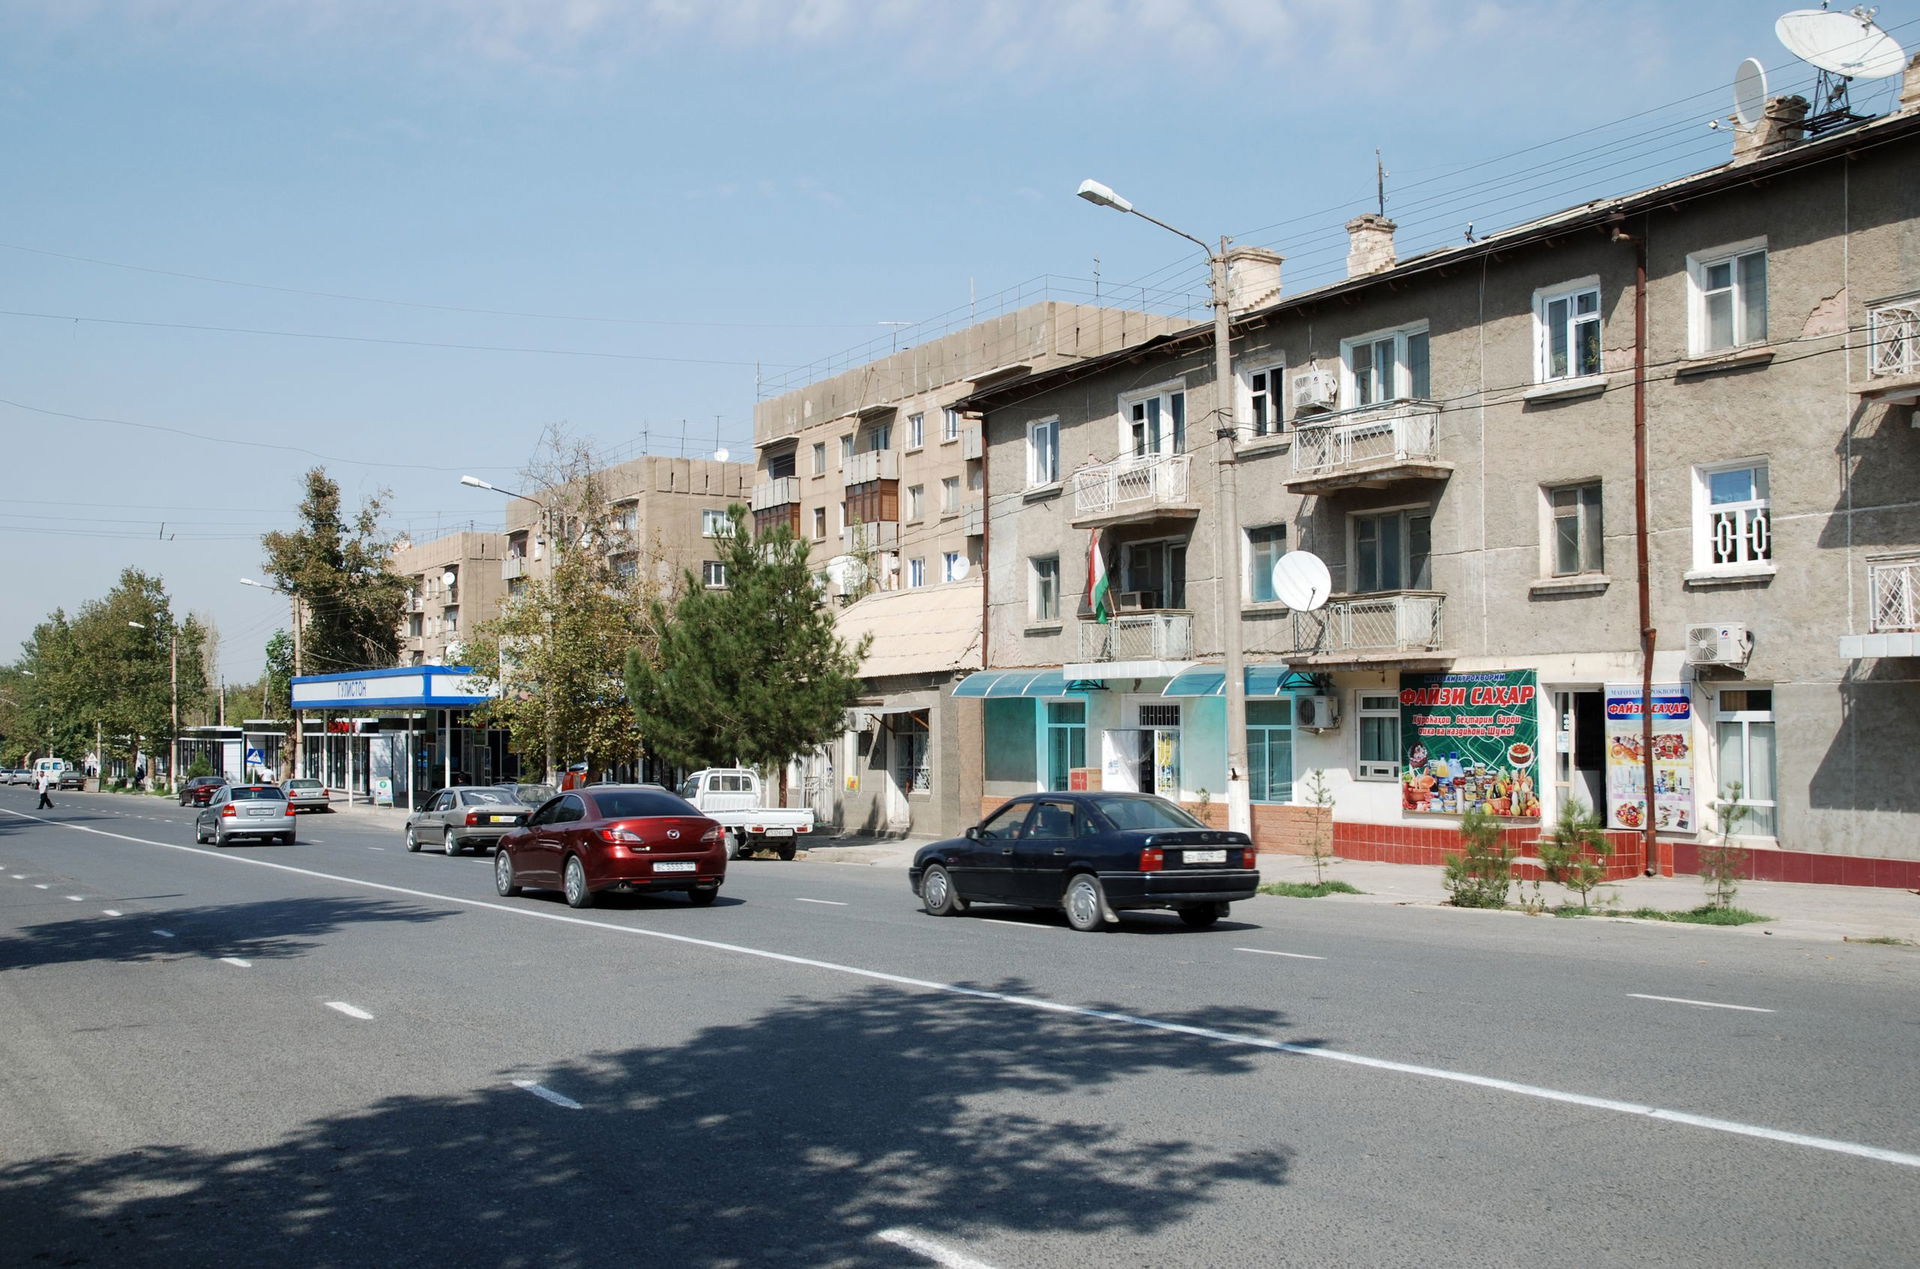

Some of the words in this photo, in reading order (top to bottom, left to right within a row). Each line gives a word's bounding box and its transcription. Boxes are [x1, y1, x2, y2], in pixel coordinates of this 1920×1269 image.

[337, 681, 367, 697] ГУЛИСТОН
[1400, 685, 1465, 705] ФАЙЗИ
[1471, 686, 1534, 706] САҲАР
